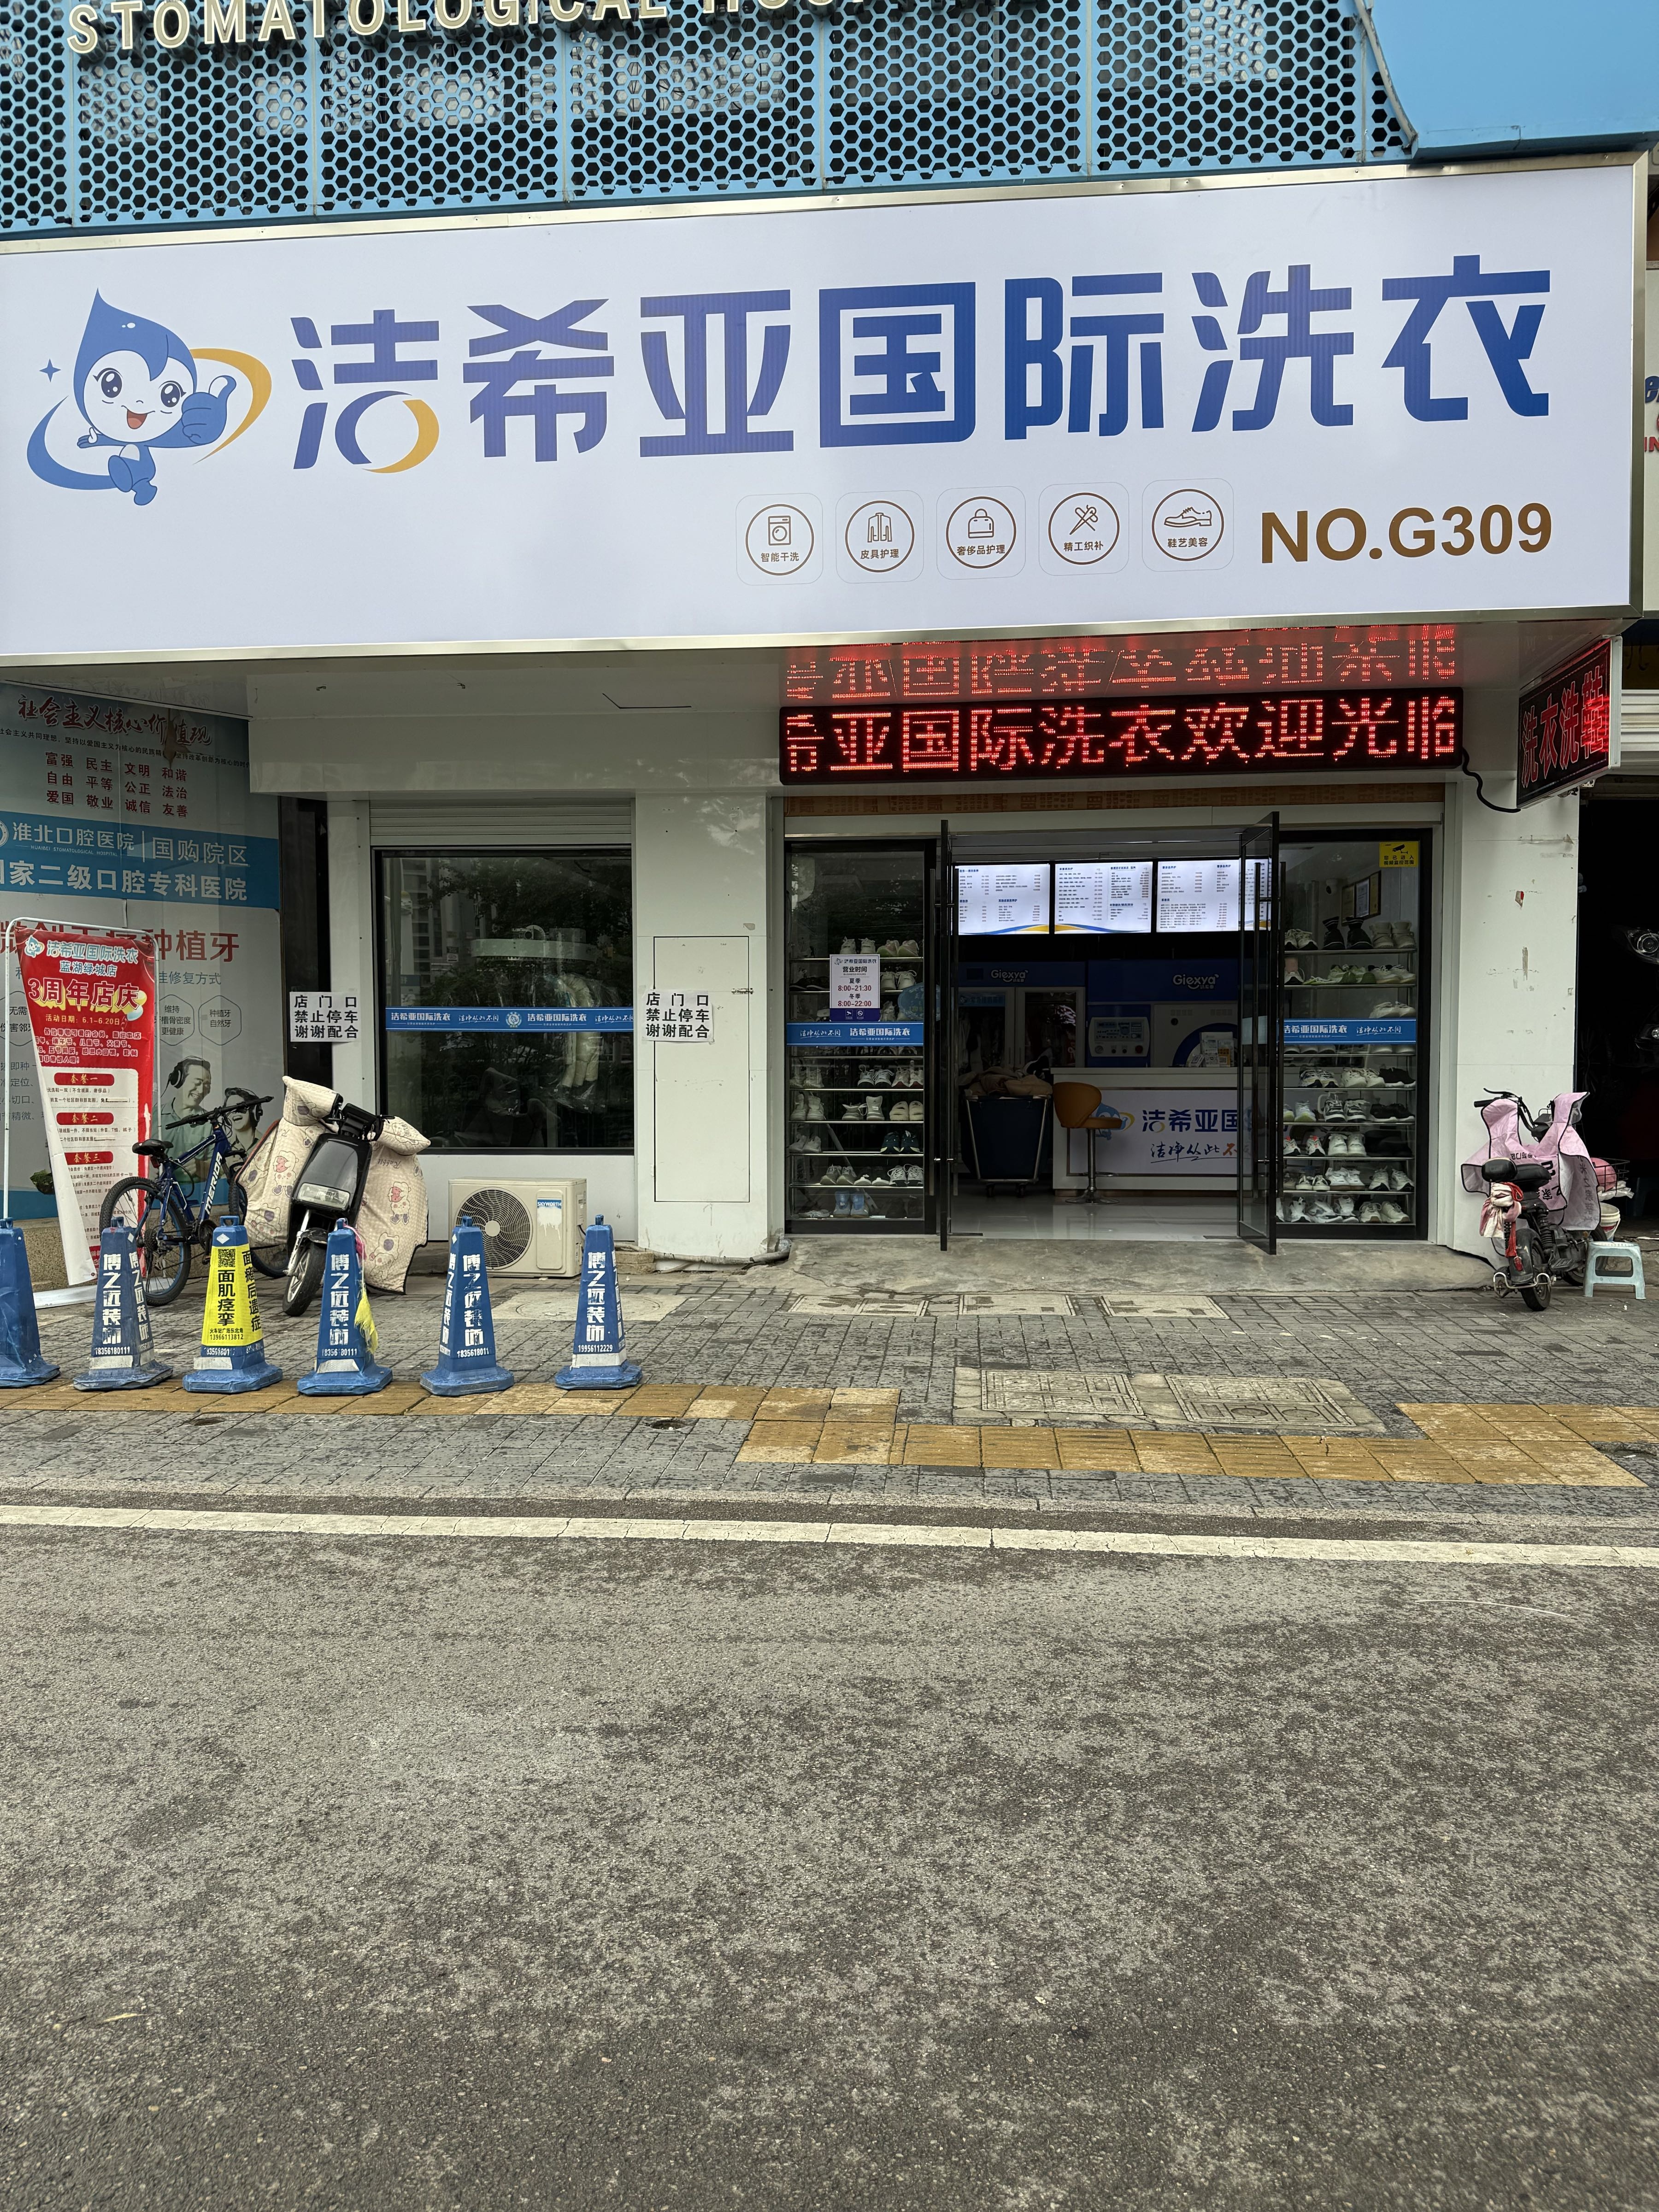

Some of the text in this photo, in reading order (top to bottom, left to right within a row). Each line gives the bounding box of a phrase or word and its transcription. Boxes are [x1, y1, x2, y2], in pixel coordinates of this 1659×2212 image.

[290, 255, 1550, 474] 洁希亚国际洗衣
[1261, 502, 1552, 564] NO.G309
[760, 537, 1208, 563] 智能干洗 皮具护理 奢侈品护理 精工织补 鞋艺美容
[1521, 665, 1604, 788] 洗衣洗鞋
[45, 752, 187, 782] 富强 民主 文明 和谐
[47, 771, 188, 800] 自由 平等 公正 法治
[46, 790, 188, 818] 爱国 敬业 诚信 友善
[12, 822, 249, 867] 淮北口腔医院 国购院区
[47, 940, 139, 964] 洁希亚国际洗衣
[59, 960, 118, 977] 蓝湖绿城店
[1172, 973, 1216, 985] Giexya
[28, 977, 140, 1010] 3周年店庆
[164, 1005, 180, 1014] 维持
[294, 1010, 359, 1024] 禁止停车
[391, 1012, 450, 1021] 洁希亚国际洗衣
[527, 1013, 587, 1022] 洁希亚国际洗衣
[646, 1008, 710, 1023] 禁止停车
[161, 1027, 184, 1035] 更健康
[210, 1019, 231, 1028] 自然牙
[294, 1025, 359, 1038] 谢谢配合
[646, 1024, 710, 1038] 谢谢配合
[849, 1028, 911, 1036] 洁希亚国际洗衣
[70, 1073, 98, 1084] 套餐一
[71, 1112, 98, 1124] 套餐二
[74, 1153, 100, 1164] 套餐三
[205, 1152, 223, 1215] MERIDA
[102, 1253, 122, 1345] 博之远装饰
[217, 1269, 235, 1326] 面肌痉挛
[242, 1250, 262, 1332] 面瘫后遗症
[586, 1251, 606, 1342] 博之远装饰
[329, 1253, 349, 1346] 博之远装饰
[94, 1346, 130, 1355] 18356180111
[322, 1348, 358, 1357] 1835680111
[457, 1347, 491, 1358] 1835618011
[578, 1344, 613, 1353] 19956112229
